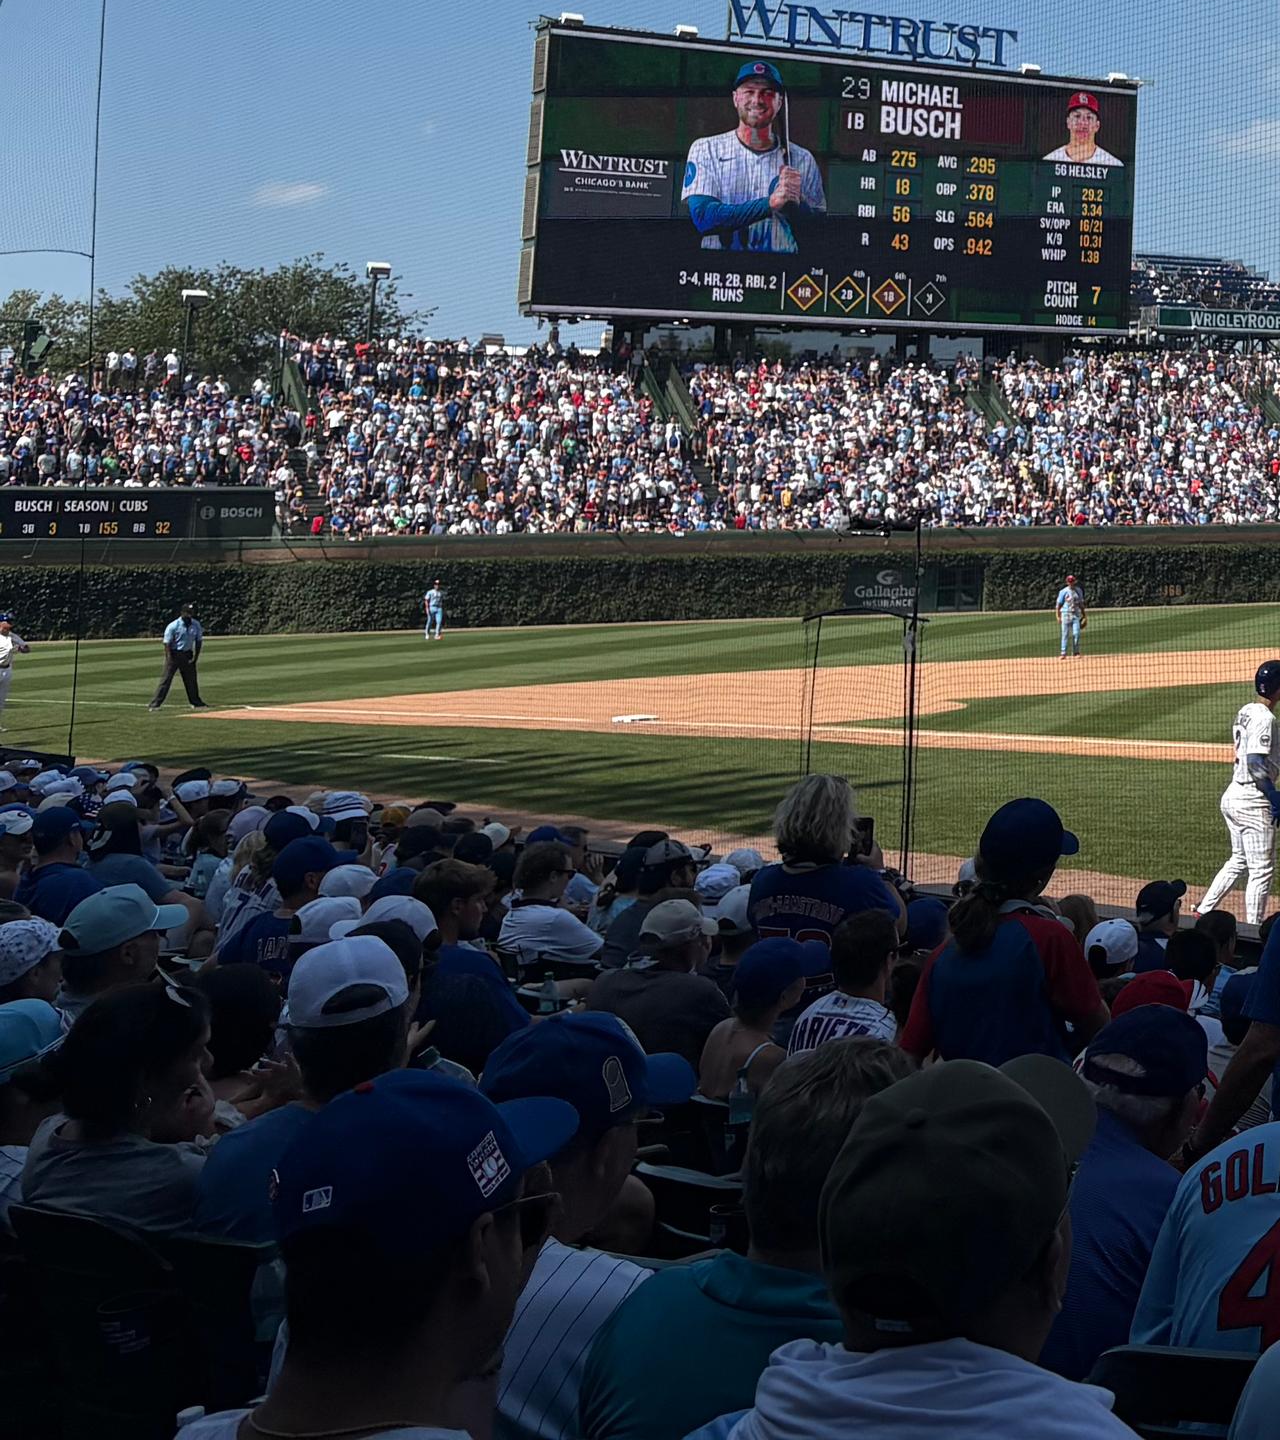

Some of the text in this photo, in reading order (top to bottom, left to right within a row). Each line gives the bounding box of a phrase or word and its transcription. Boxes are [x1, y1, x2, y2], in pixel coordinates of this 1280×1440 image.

[841, 76, 963, 109] 29 MICHAEL
[880, 105, 962, 140] BUSCH
[560, 149, 668, 174] WINTRUST
[862, 149, 996, 174] AB 275 AVG .295
[1068, 165, 1109, 179] HELSLEY
[575, 177, 649, 190] CHICAGO'S BANK
[860, 176, 995, 201] HR 18 OBP .378
[1051, 186, 1103, 202] IP 29.2
[1046, 201, 1103, 217] ERA 3.34
[857, 204, 994, 229] RBI 56 SLG .564
[1039, 217, 1103, 233] SV/OPP 16/21
[861, 232, 993, 256] R 43 OPS .942
[1046, 233, 1102, 249] K/9 10.31
[1041, 248, 1100, 264] WHIP 1.38
[810, 267, 824, 276] 2nd
[853, 269, 865, 278] 4th
[935, 274, 947, 283] 7th
[704, 273, 723, 288] HR,
[725, 273, 743, 289] 2B,
[745, 274, 768, 290] RBI,
[769, 275, 777, 290] 2
[712, 288, 744, 302] RUNS
[798, 287, 811, 298] HR
[841, 289, 853, 300] 2B
[883, 291, 895, 302] 1B
[1046, 280, 1102, 305] PITCH 7
[1043, 294, 1079, 308] COUNT
[1055, 314, 1097, 327] HODGE 14
[14, 500, 148, 512] BUSCH SEASON CUBS
[220, 507, 262, 518] BOSCH
[49, 522, 57, 534] 3
[99, 521, 118, 534] 155
[155, 521, 170, 534] 32
[854, 584, 917, 599] Gallaghe
[862, 599, 914, 608] INSURANCE
